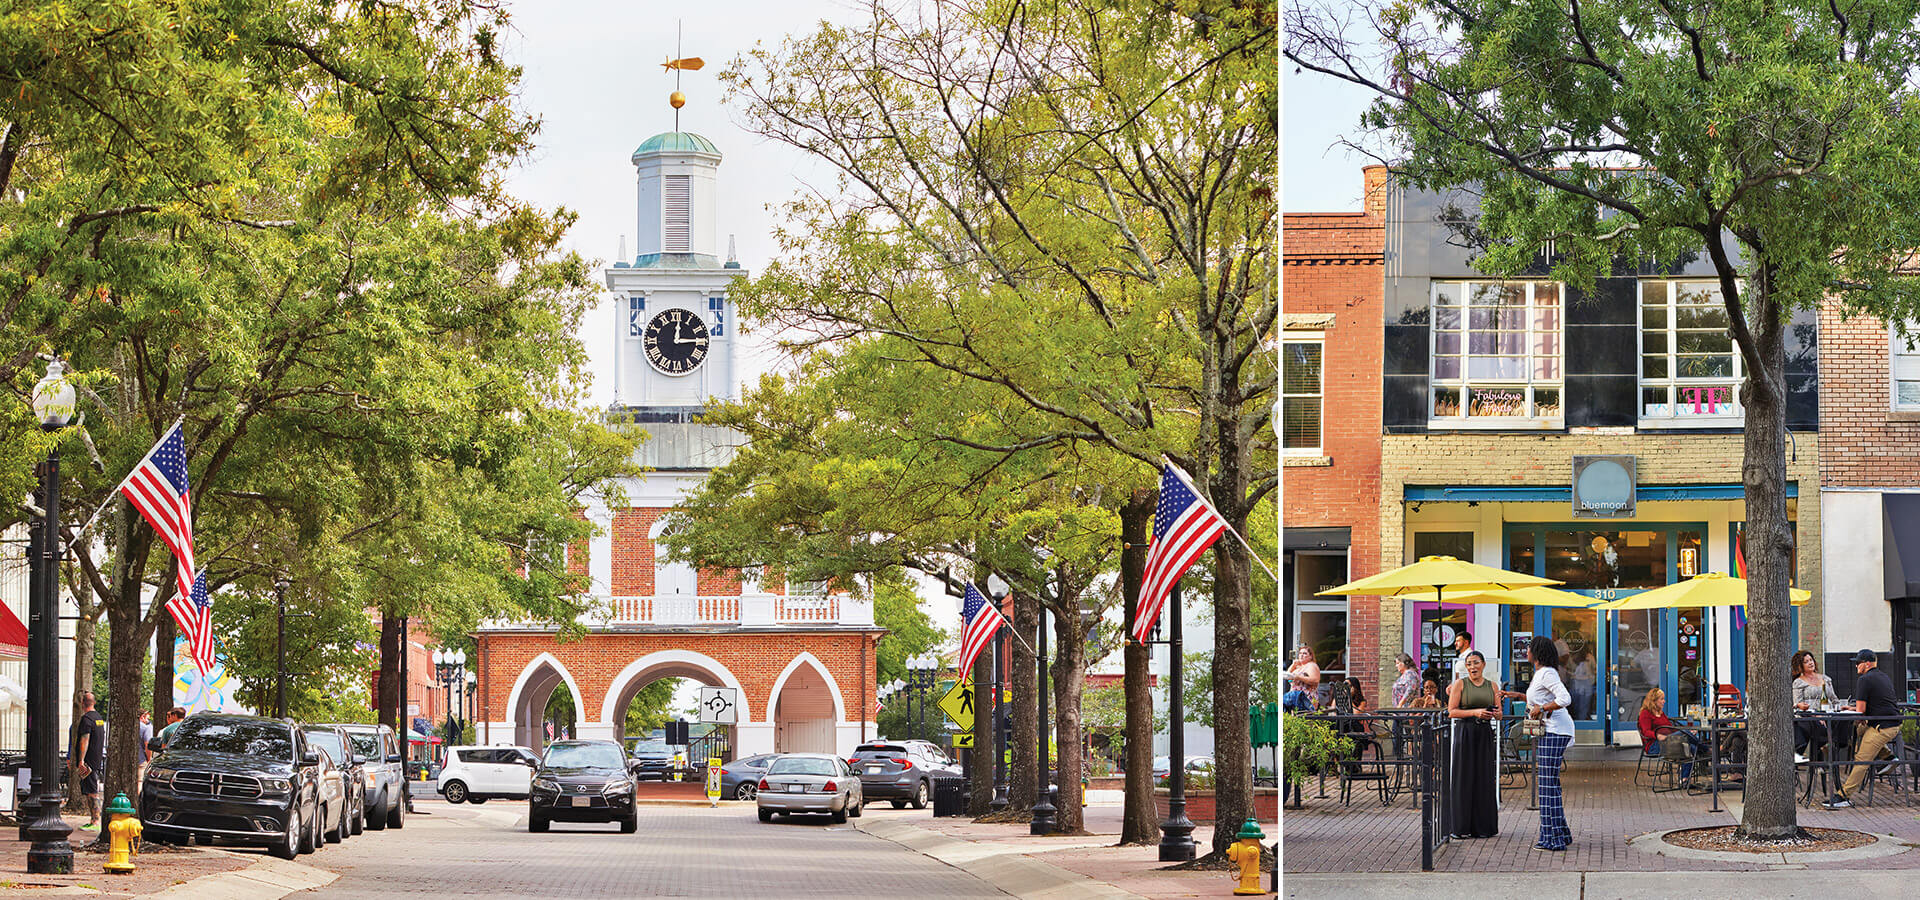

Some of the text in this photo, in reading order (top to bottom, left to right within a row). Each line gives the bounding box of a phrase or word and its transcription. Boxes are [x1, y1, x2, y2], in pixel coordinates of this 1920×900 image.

[670, 311, 682, 322] XII
[1474, 388, 1523, 401] Fabulous
[1580, 500, 1628, 510] bluemoon
[1594, 589, 1616, 600] 310
